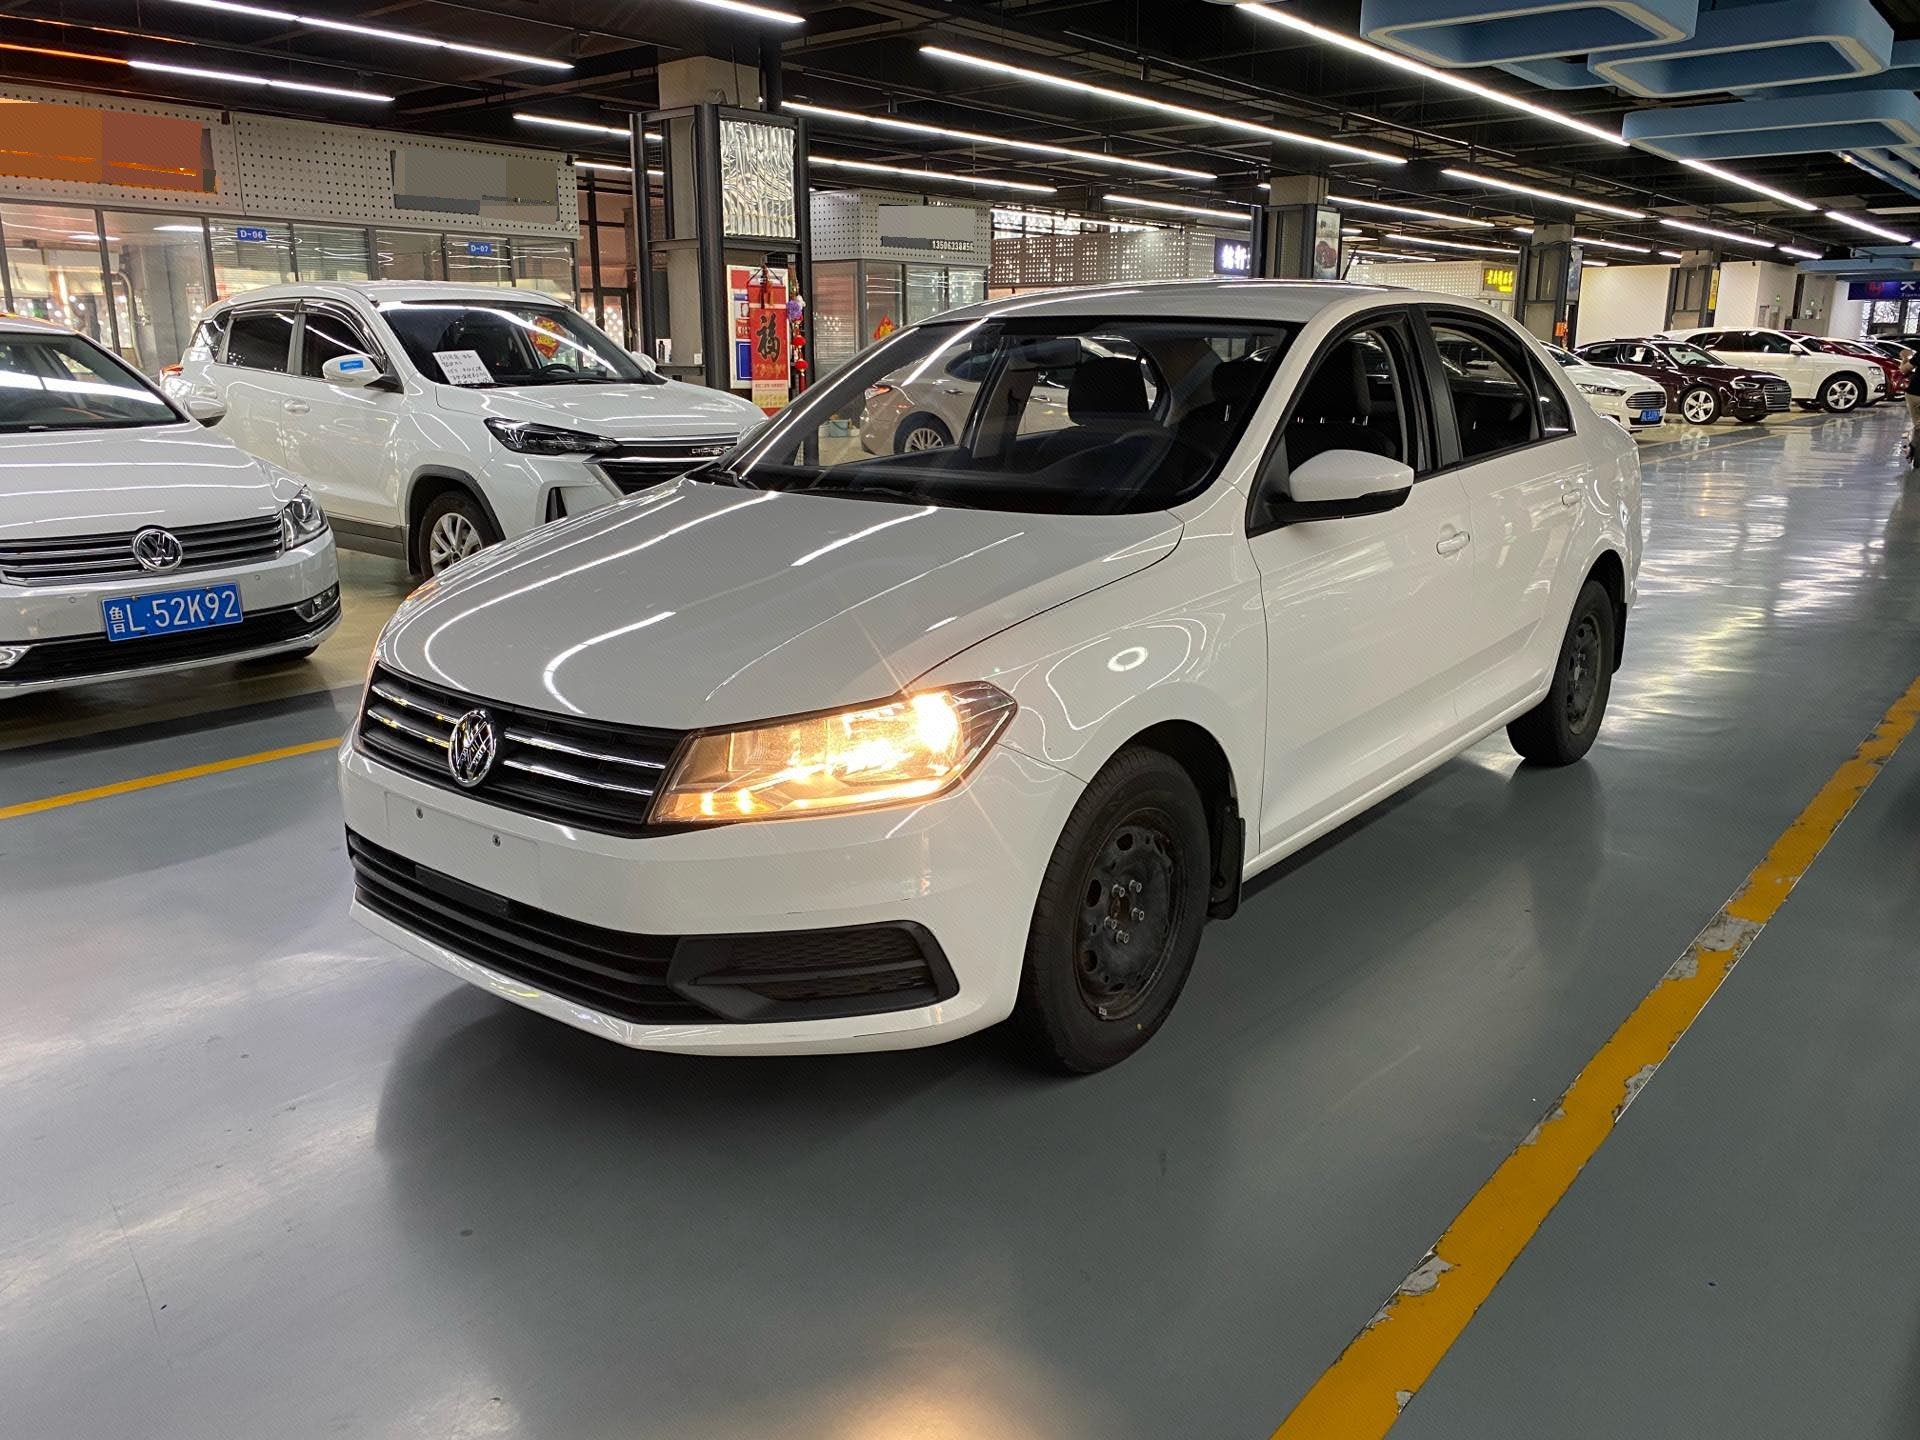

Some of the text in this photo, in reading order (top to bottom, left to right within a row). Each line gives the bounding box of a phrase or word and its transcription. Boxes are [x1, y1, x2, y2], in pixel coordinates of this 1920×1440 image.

[240, 230, 263, 239] D-06
[470, 244, 489, 252] D-07
[756, 313, 781, 363] 福
